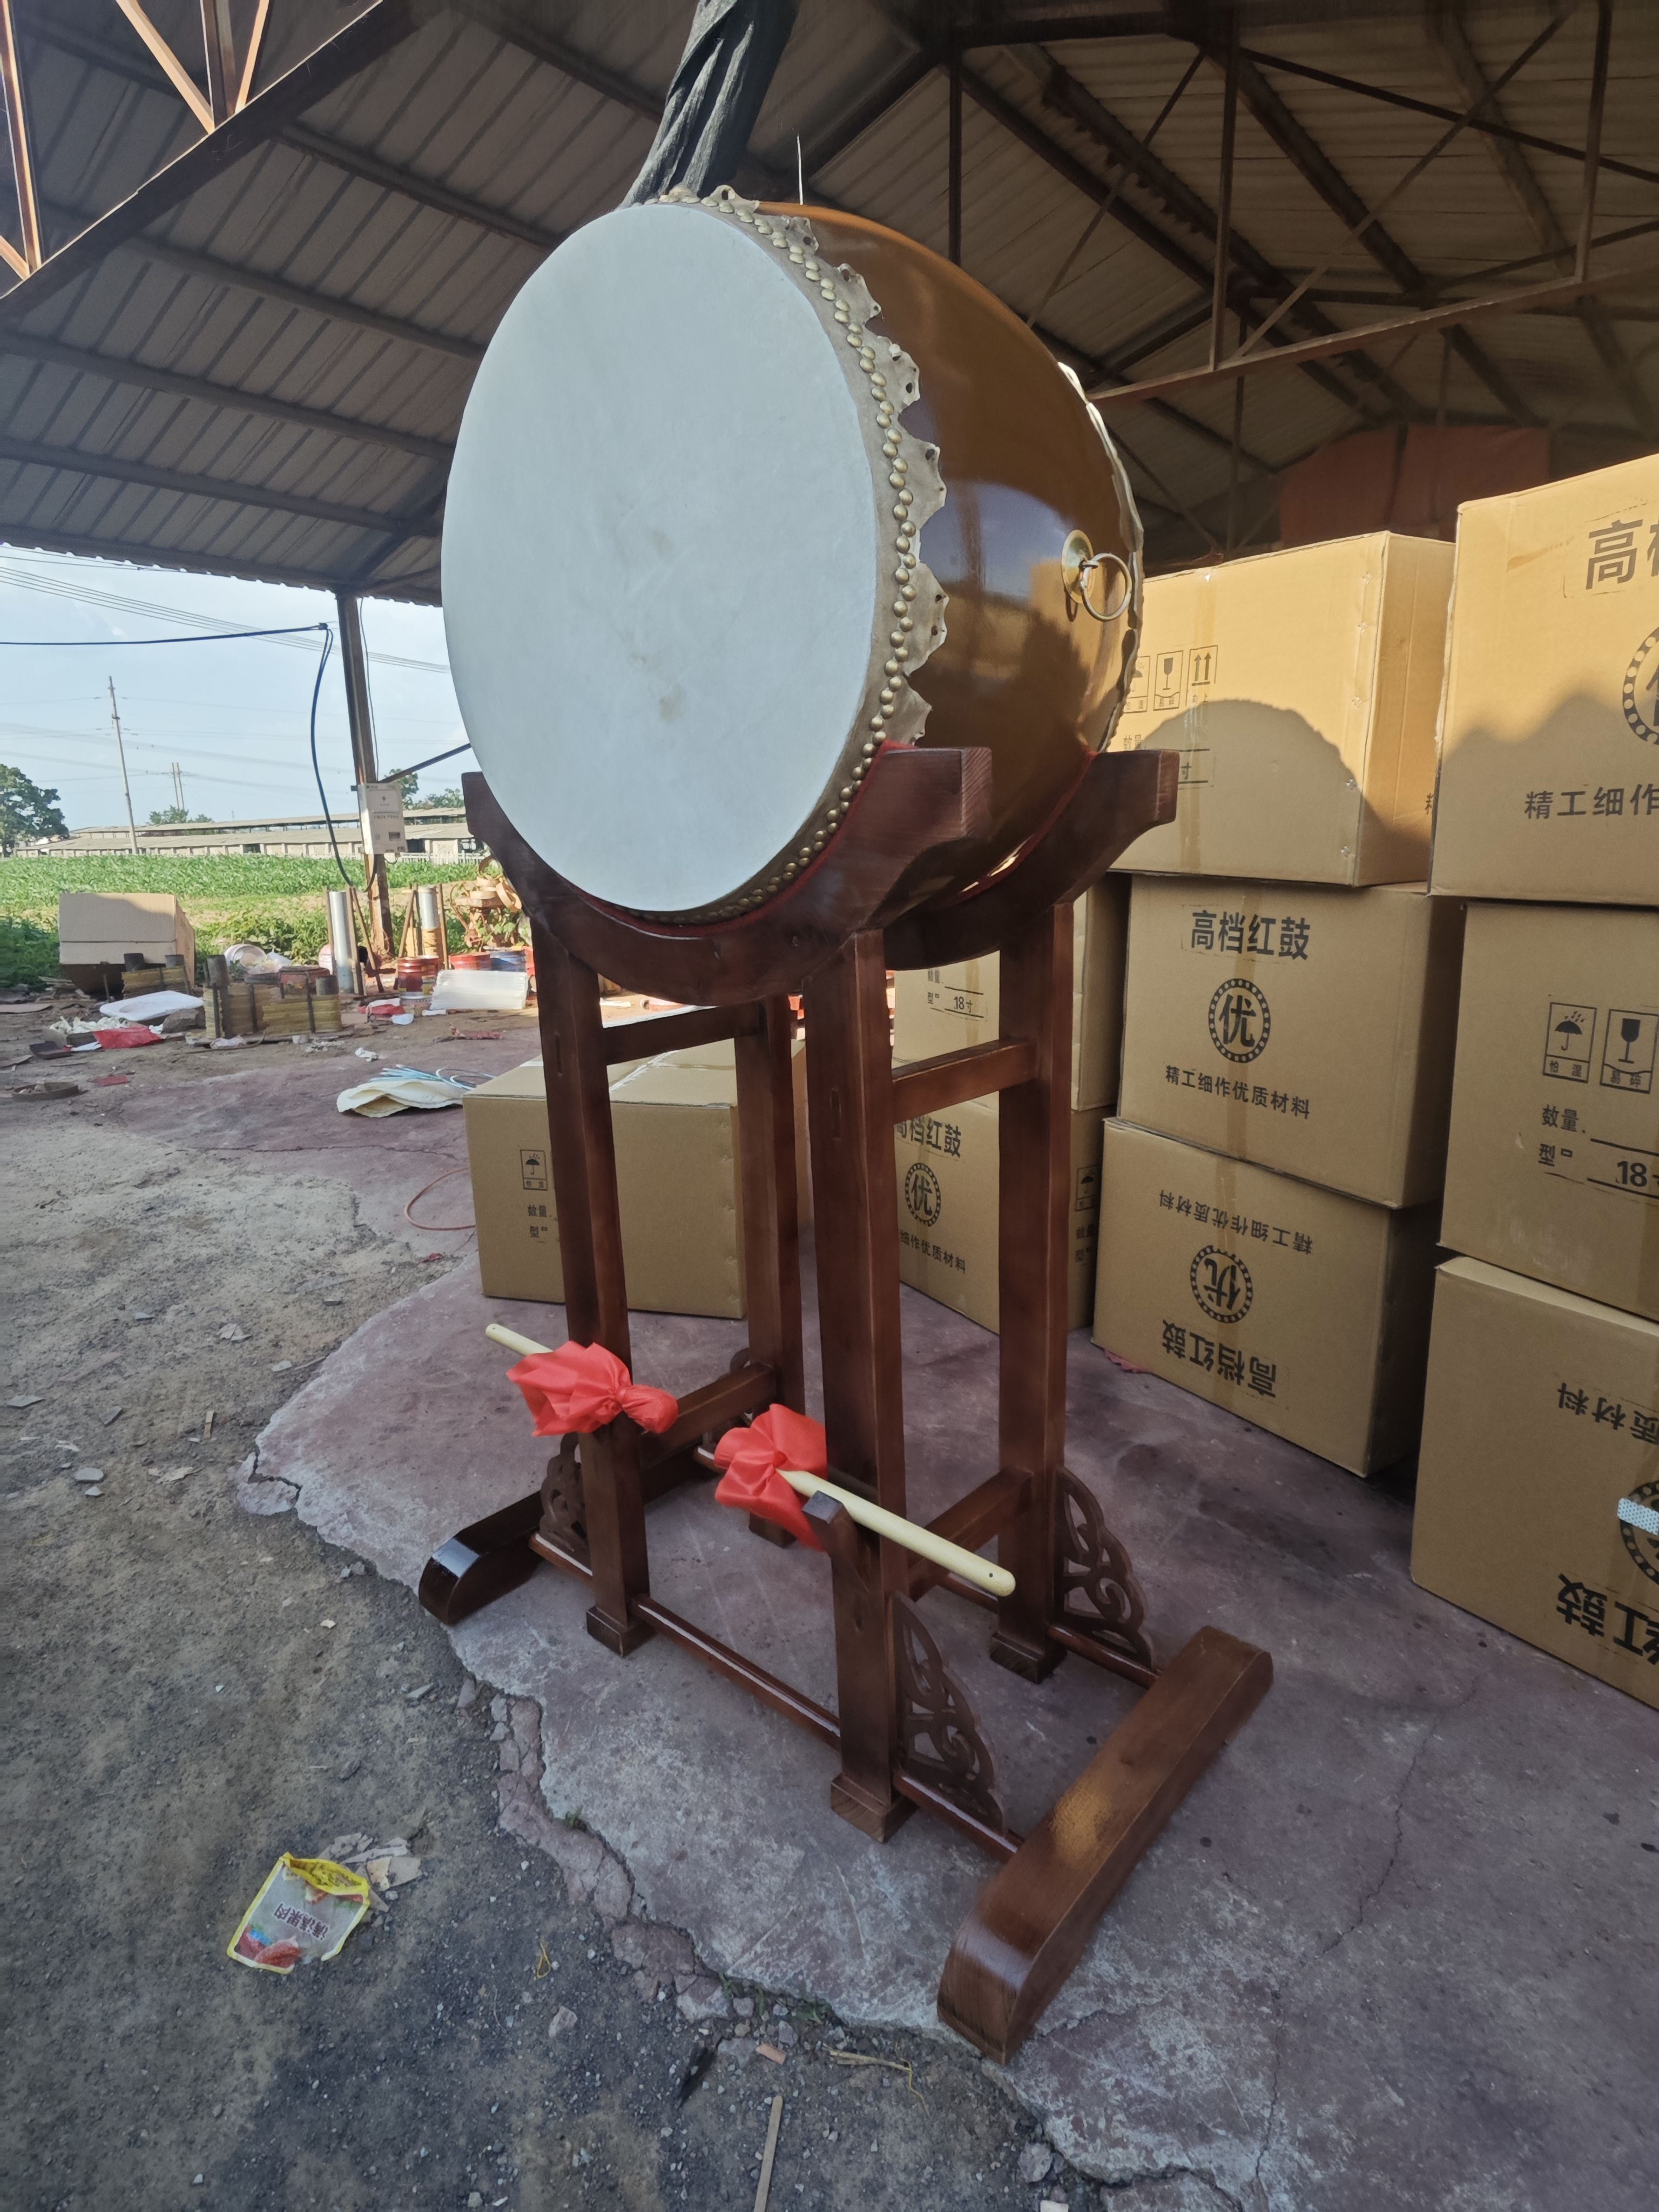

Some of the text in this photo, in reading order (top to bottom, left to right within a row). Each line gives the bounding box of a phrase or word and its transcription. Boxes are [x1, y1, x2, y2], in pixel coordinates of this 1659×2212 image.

[1524, 784, 1659, 819] 精工细作
[1191, 910, 1310, 960] 高档红鼓
[1165, 1065, 1310, 1119] 精工细作优质材料
[1617, 1161, 1659, 1188] 18
[1159, 1190, 1312, 1255] 精工细作优质材料
[1162, 1319, 1276, 1398] 高档红鼓
[1557, 1382, 1659, 1445] 质材料
[1556, 1573, 1659, 1665] 红鼓
[274, 1903, 328, 1941] 满满果肉
